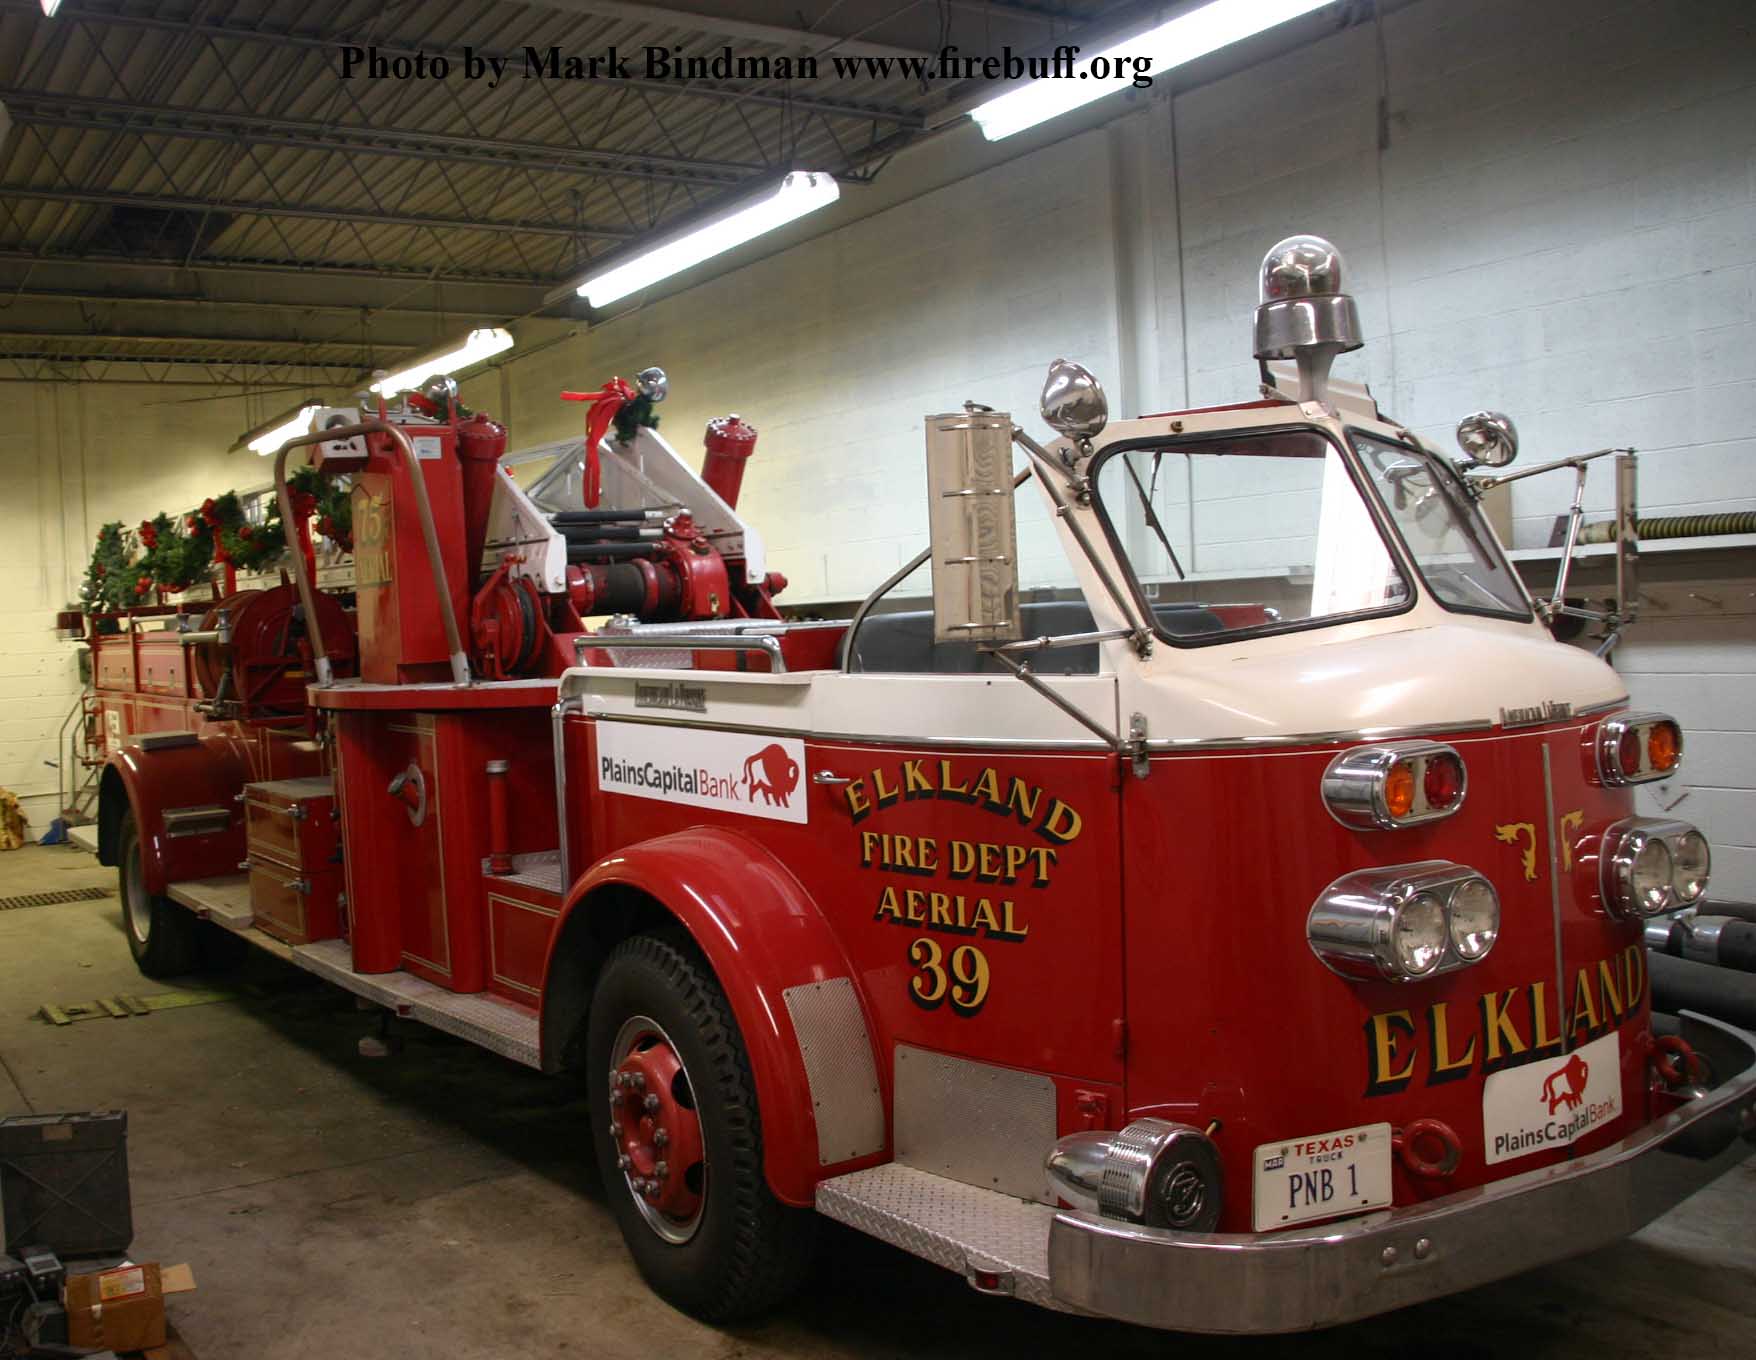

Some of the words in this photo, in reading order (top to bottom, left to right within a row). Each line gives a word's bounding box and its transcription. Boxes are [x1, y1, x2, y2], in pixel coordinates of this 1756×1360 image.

[845, 759, 1082, 845] ELKLAND
[861, 831, 938, 876] FIRE
[950, 840, 1057, 888] DEPT
[874, 886, 1028, 943] AERIAL
[908, 937, 990, 1018] 39
[1363, 944, 1644, 1098] ELKLAND
[1295, 1134, 1355, 1157] TEXAS
[1309, 1151, 1344, 1165] TRUCK
[1289, 1168, 1334, 1208] PNB
[1347, 1163, 1359, 1197] 1
